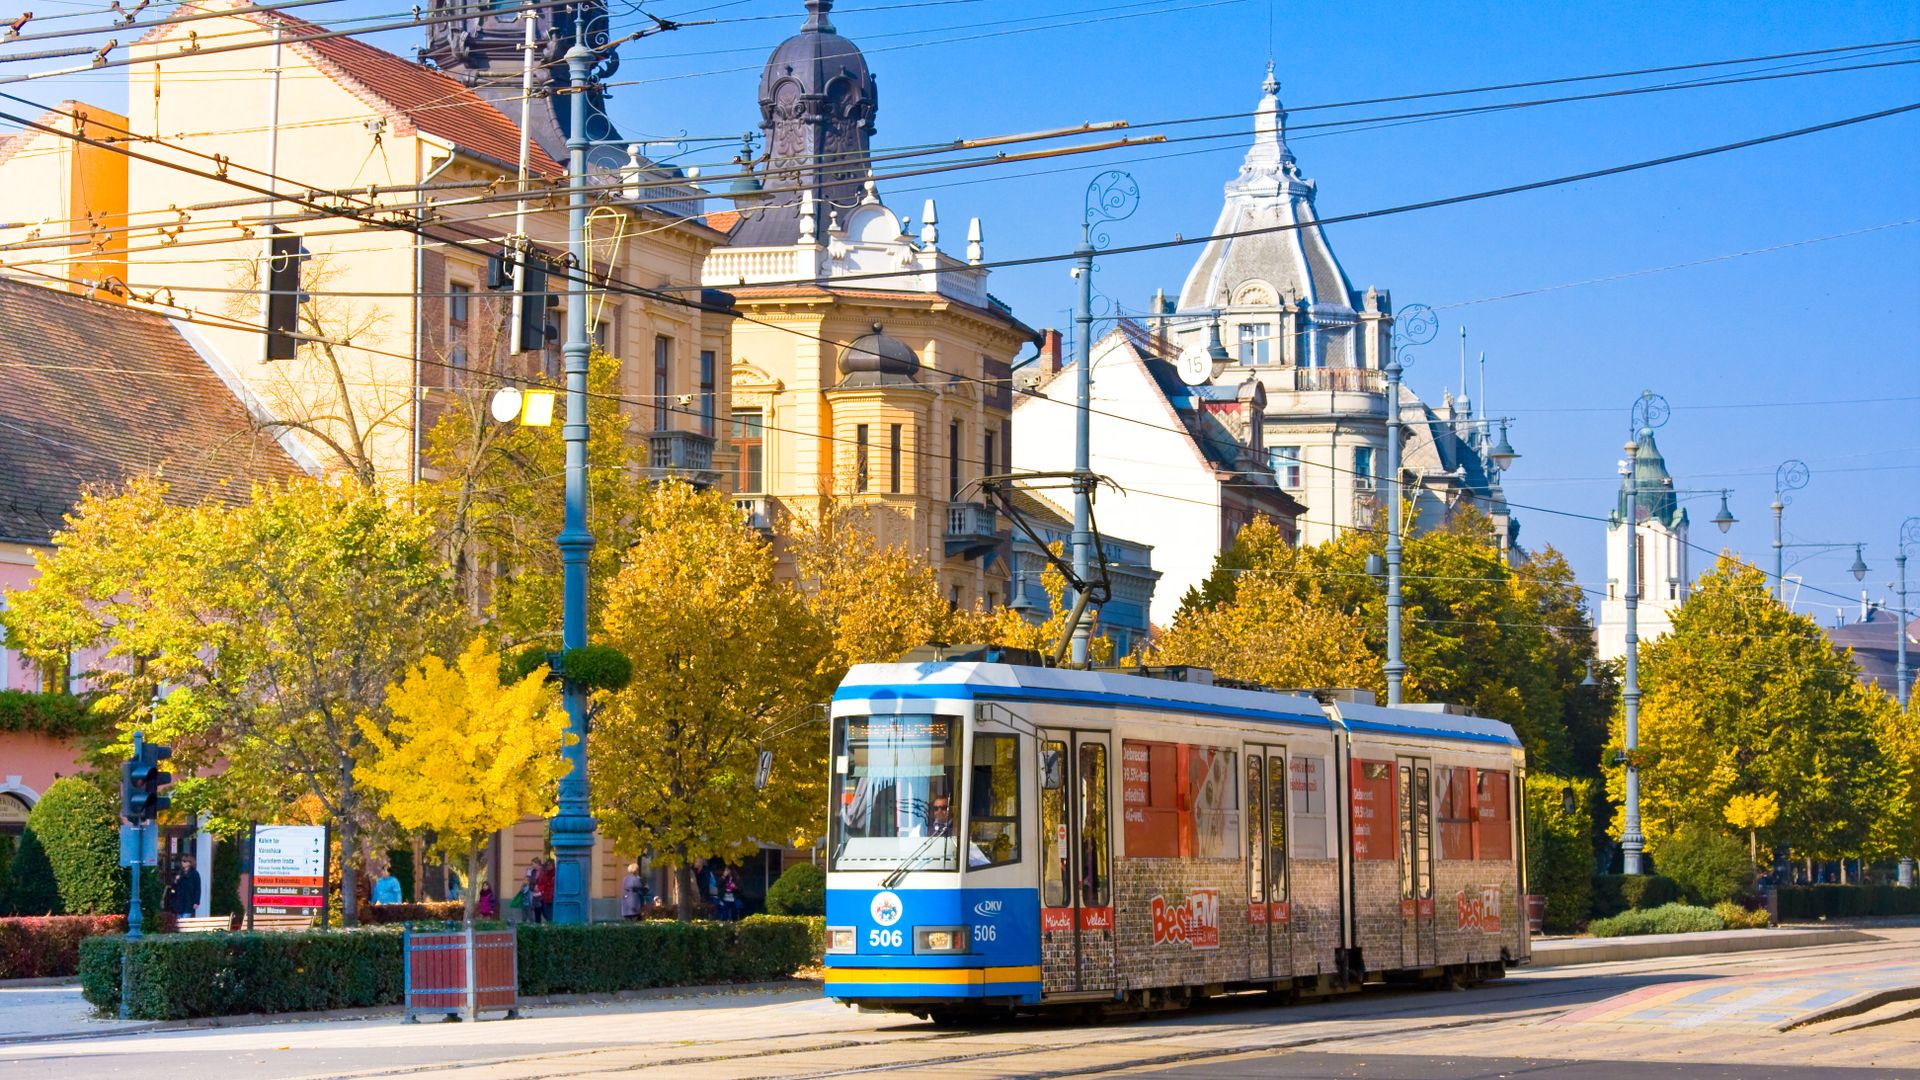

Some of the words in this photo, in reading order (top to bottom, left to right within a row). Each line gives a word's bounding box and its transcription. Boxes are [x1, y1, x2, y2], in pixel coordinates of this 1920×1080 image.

[1187, 356, 1203, 374] 15
[985, 900, 1002, 912] DKV
[869, 929, 903, 948] 506
[974, 924, 997, 942] 506
